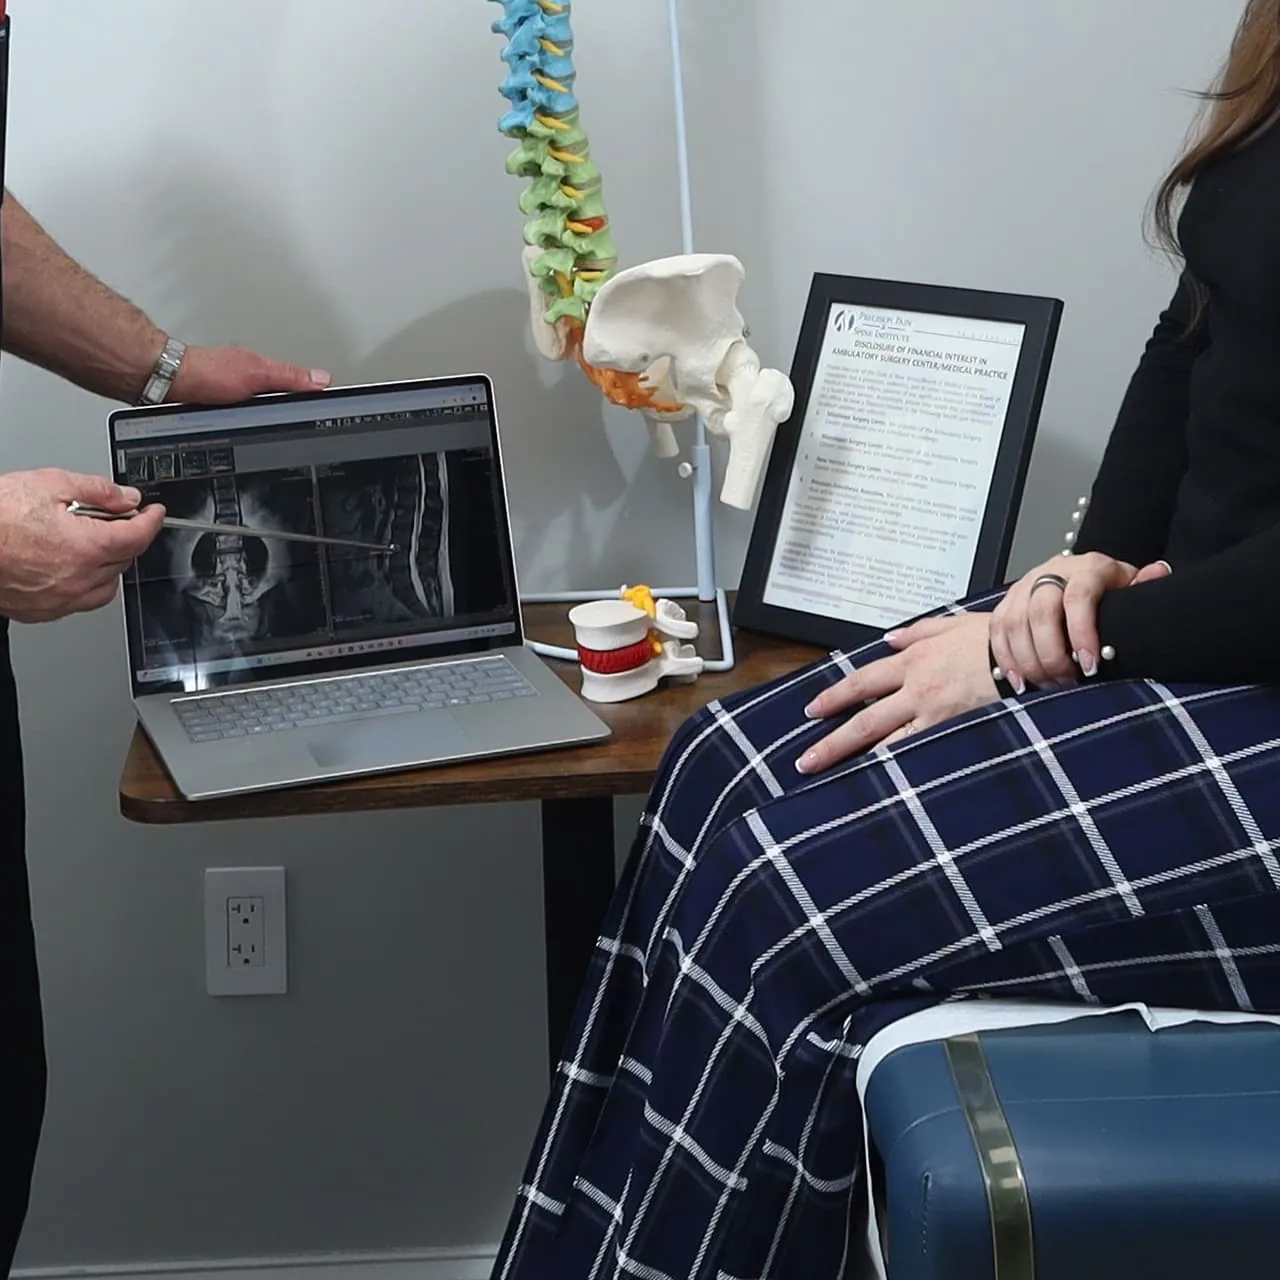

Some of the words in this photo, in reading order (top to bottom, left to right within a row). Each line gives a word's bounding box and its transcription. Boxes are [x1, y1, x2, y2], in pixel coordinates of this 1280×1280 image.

[831, 347, 879, 361] AMBULATORY
[879, 354, 912, 367] SURGERY
[972, 368, 1009, 380] PRACTICE
[854, 340, 896, 353] DISCLOSURE
[896, 346, 906, 354] OF
[906, 347, 944, 360] FINANCIAL
[944, 352, 979, 365] INTEREST
[978, 358, 988, 366] IN
